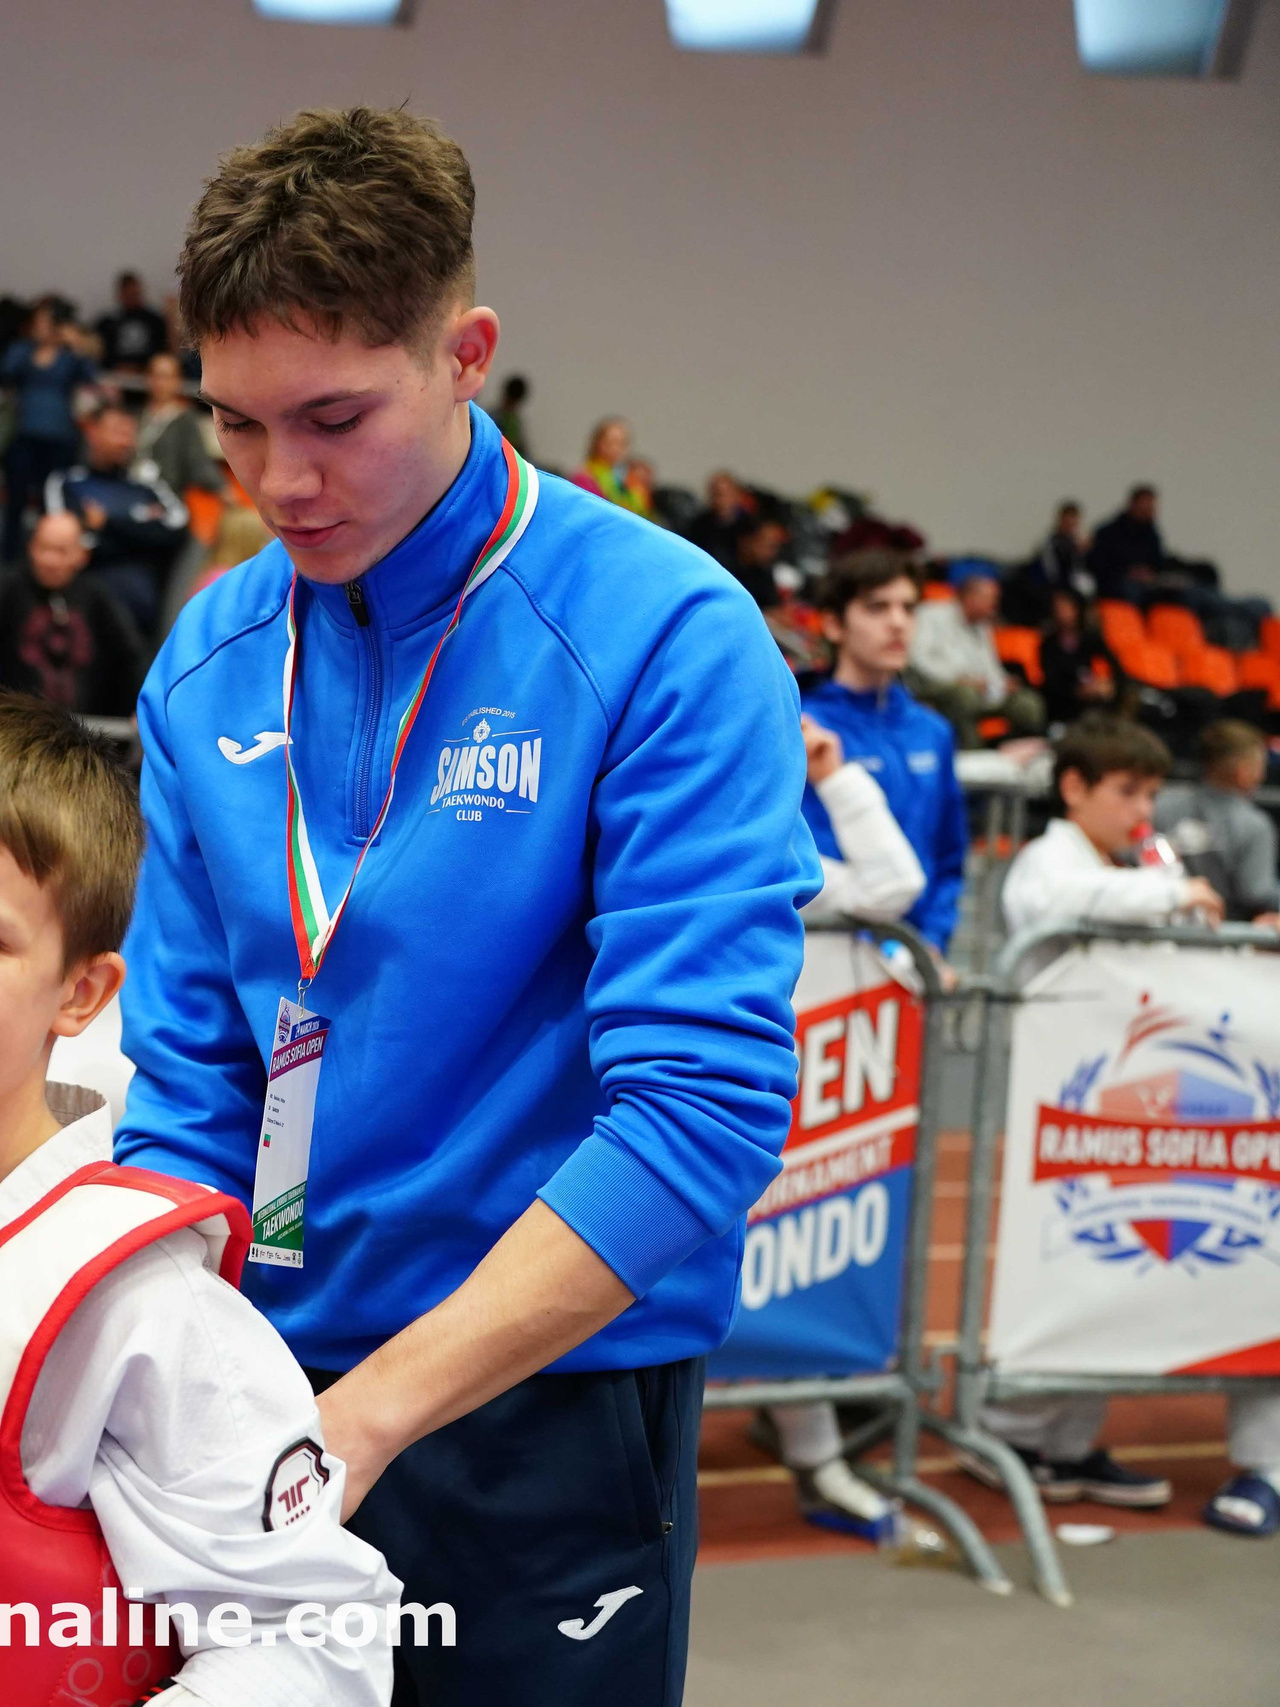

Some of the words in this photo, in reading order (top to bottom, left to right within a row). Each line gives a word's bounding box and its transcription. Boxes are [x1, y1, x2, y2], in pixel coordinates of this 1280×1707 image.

[430, 738, 542, 804] SAMSON
[442, 794, 505, 809] TAEKWONDO
[456, 810, 483, 822] CLUB
[272, 1049, 290, 1074] RAMUS
[290, 1042, 306, 1063] SOFIA
[306, 1036, 324, 1056] OPEN
[794, 998, 900, 1130] EN
[1039, 1122, 1143, 1166] RAMUS
[1146, 1127, 1228, 1169] SOFIA
[263, 1198, 304, 1241] TAEKWONDO
